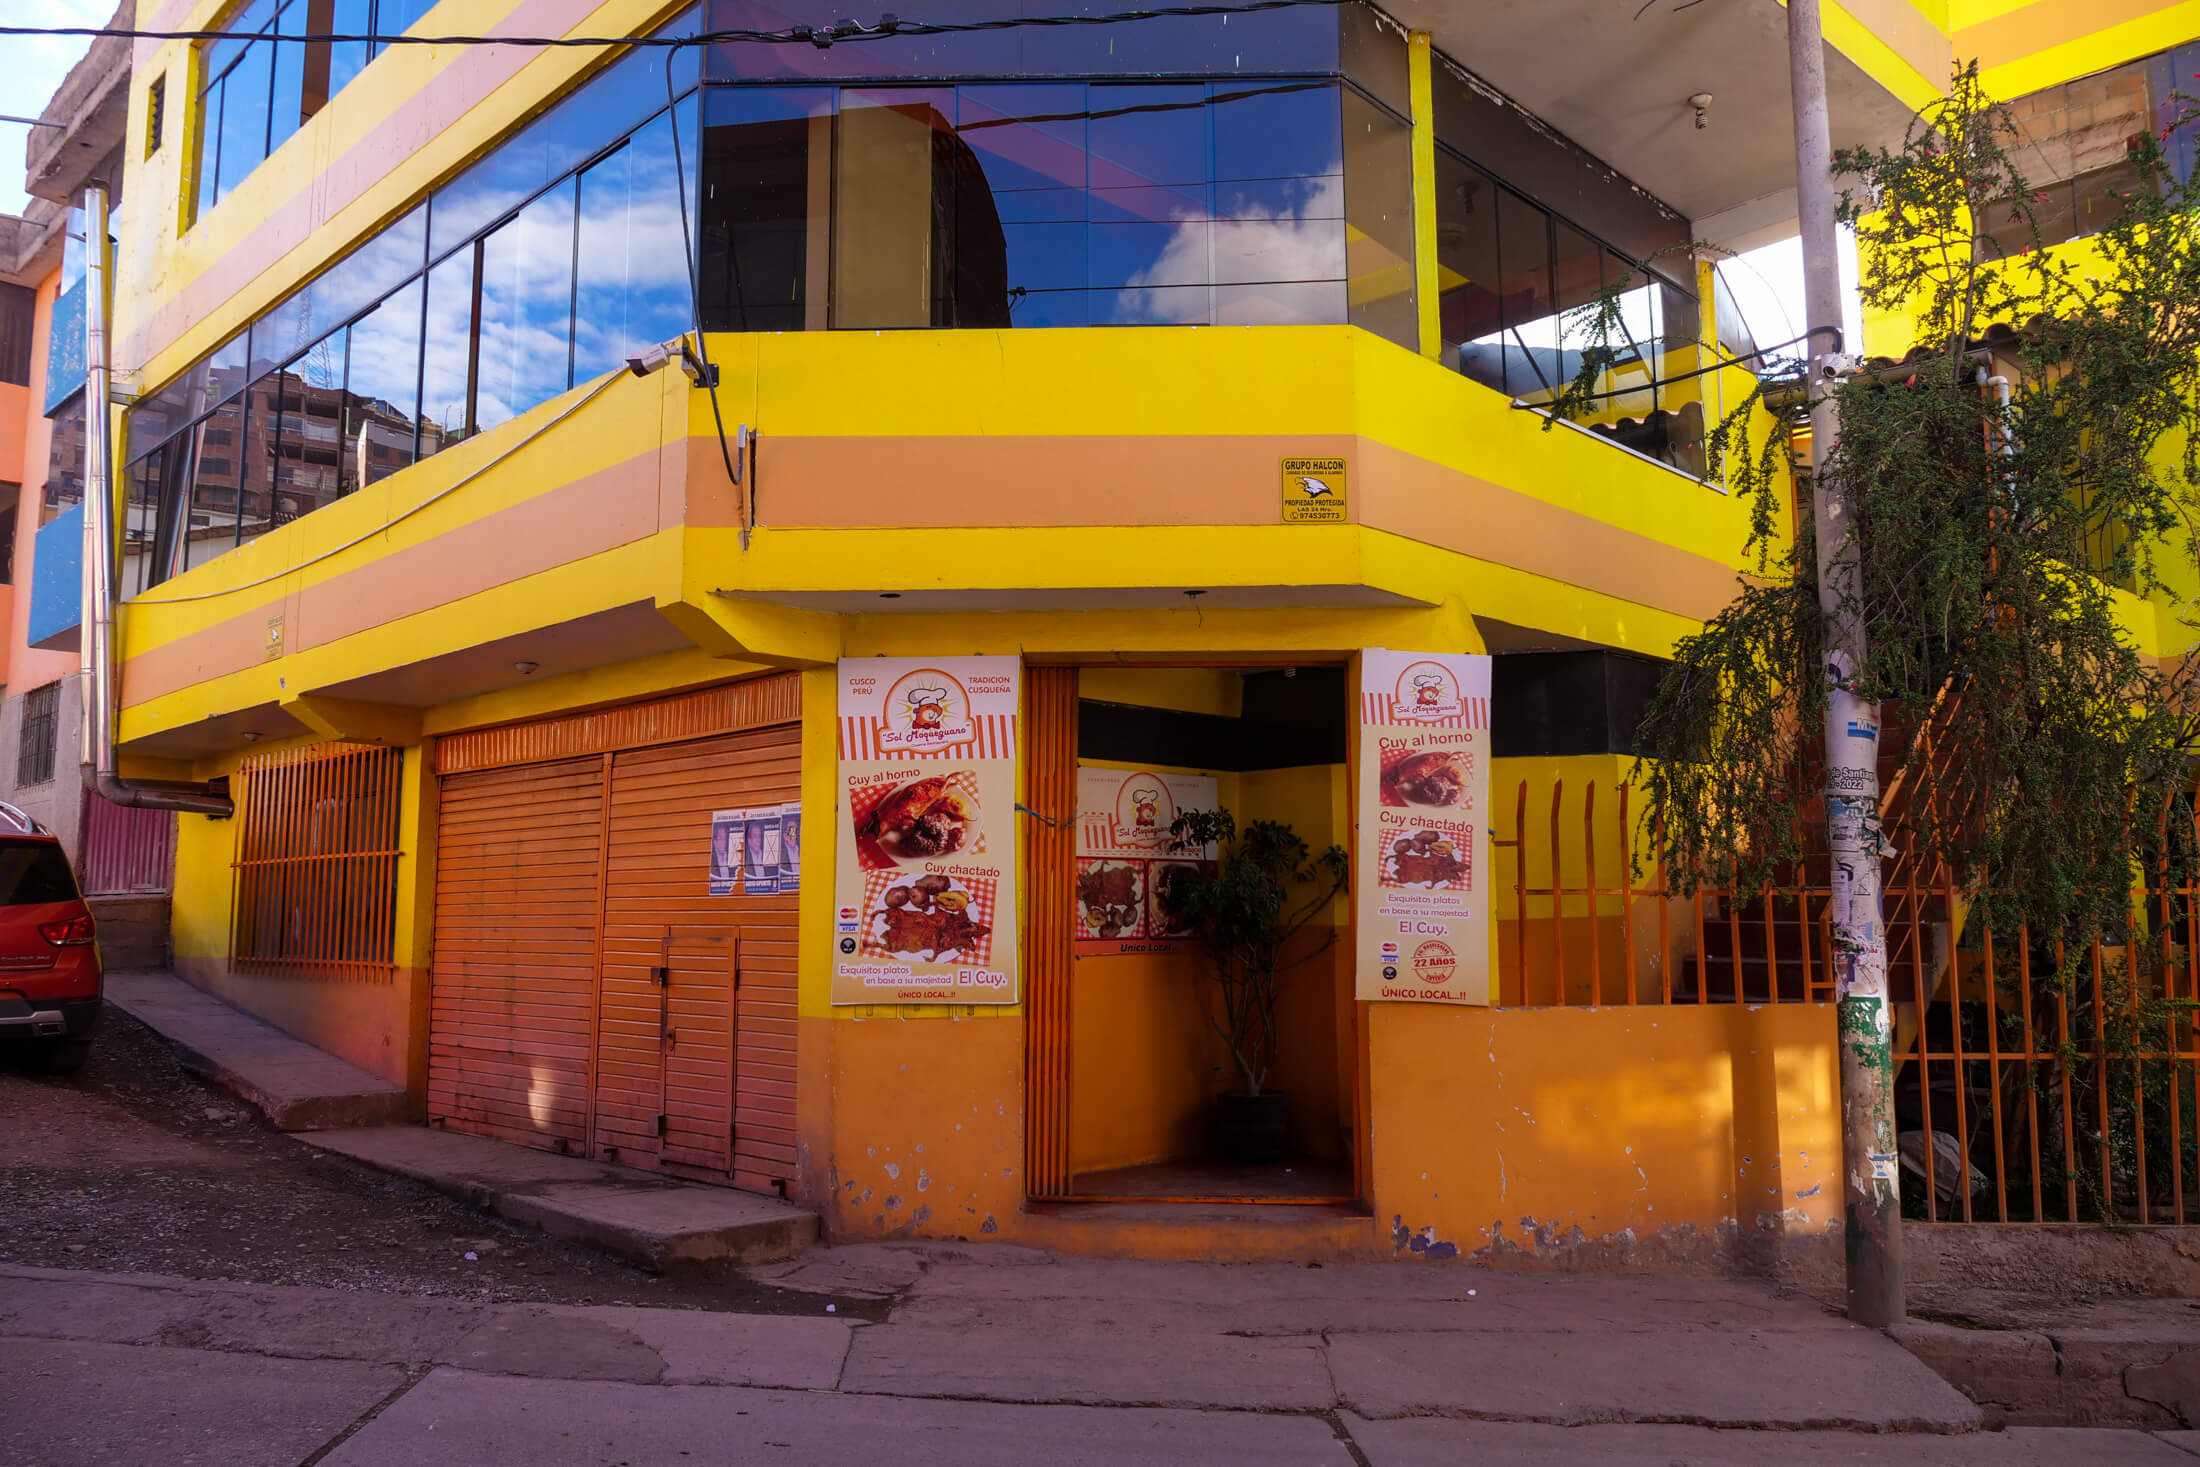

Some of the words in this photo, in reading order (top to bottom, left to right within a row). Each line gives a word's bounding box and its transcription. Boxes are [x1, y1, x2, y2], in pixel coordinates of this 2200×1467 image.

[1285, 460, 1311, 470] GRUPO
[1312, 460, 1344, 470] HALCON
[850, 678, 876, 686] CUSCO
[852, 686, 873, 695] PERÚ
[968, 685, 1011, 694] CUSQUEÑA
[1378, 737, 1408, 750] Cuy
[1412, 734, 1425, 747] al
[1429, 732, 1473, 745] horno
[848, 775, 870, 786] Cuy
[873, 772, 884, 783] al
[886, 768, 921, 780] horno
[1840, 779, 1864, 790] 2022
[1380, 811, 1407, 825] Cuy
[1409, 814, 1474, 833] chactado
[924, 862, 947, 874] Cuy
[949, 864, 1000, 877] chactado
[1388, 894, 1431, 904] Exquisitos
[1433, 894, 1460, 905] platos
[1392, 906, 1411, 916] base
[1431, 907, 1469, 918] majestad
[1400, 921, 1412, 933] El
[1416, 922, 1448, 937] Cuy.
[1414, 958, 1428, 967] 22
[1430, 957, 1456, 966] Años
[840, 965, 882, 976] Exquisitos
[883, 966, 910, 976] platos
[877, 976, 896, 984] base
[915, 976, 952, 986] majestad
[959, 970, 972, 984] El
[975, 971, 1006, 986] Cuy.
[898, 990, 922, 999] ÚNICO
[1381, 986, 1416, 999] ÚNICO
